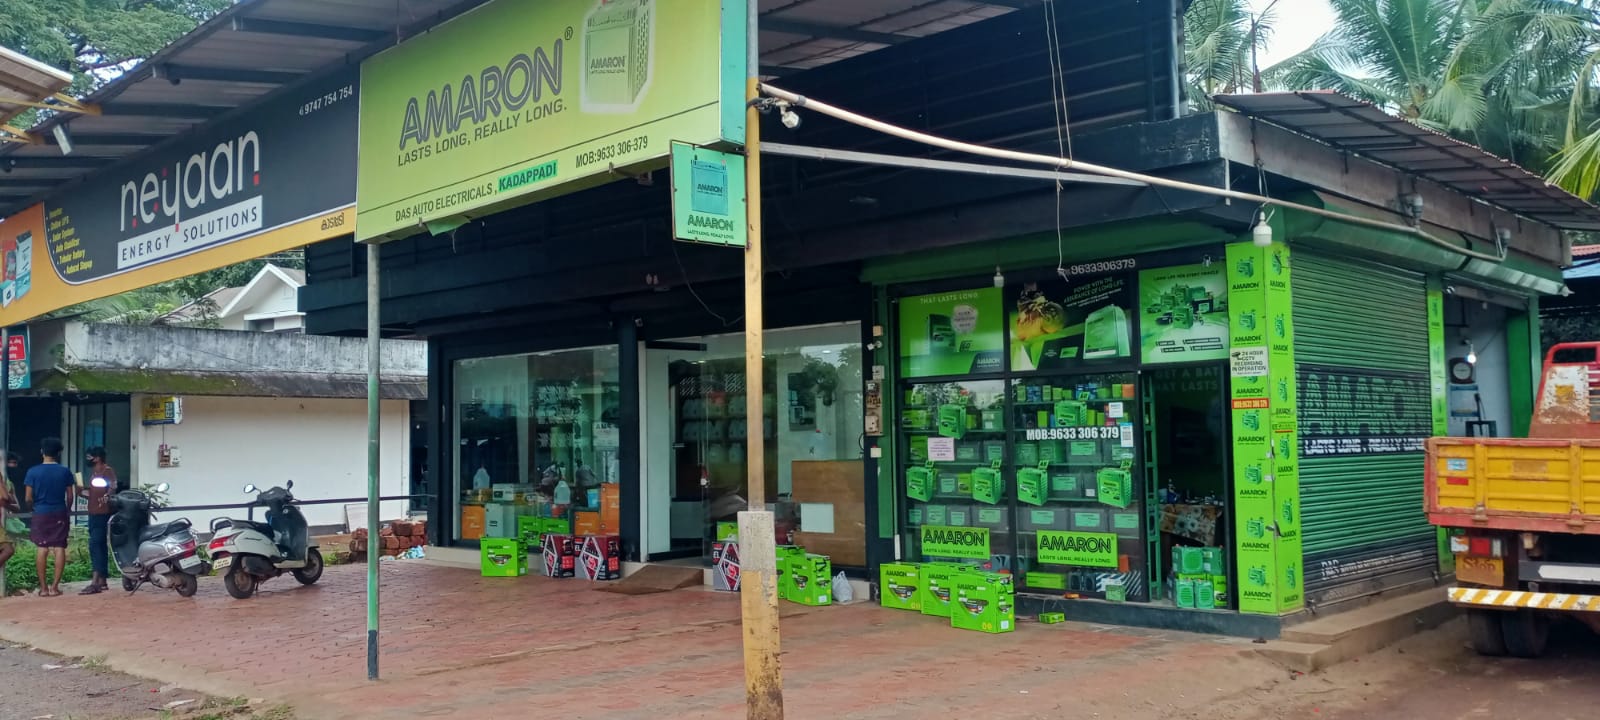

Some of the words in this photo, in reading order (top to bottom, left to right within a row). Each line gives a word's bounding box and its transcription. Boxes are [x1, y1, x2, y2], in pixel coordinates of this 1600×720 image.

[591, 56, 625, 69] AMARON
[304, 98, 322, 114] 9747
[324, 91, 337, 106] 754
[339, 84, 353, 100] 754
[400, 38, 563, 150] AMARON
[397, 145, 432, 167] LASTS
[435, 132, 471, 154] LONG,
[474, 113, 521, 141] REALLY
[525, 98, 568, 123] LONG.
[575, 144, 615, 169] MOB:9633
[395, 207, 412, 222] DAS
[412, 201, 434, 218] AUTO
[435, 182, 493, 210] ELECTRICALS
[498, 162, 557, 190] KADAPPADI
[697, 183, 722, 193] AMARON
[687, 214, 734, 231] AMARON
[122, 233, 171, 261] ENERGY
[183, 206, 258, 243] SOLUTIONS
[1071, 258, 1136, 275] 9633306379
[1232, 282, 1259, 290] AMARON
[920, 295, 935, 304] THAT
[938, 294, 957, 302] LASTS
[1027, 428, 1076, 440] MOB:9633
[1078, 427, 1098, 439] 306
[1100, 426, 1119, 438] 379
[1305, 439, 1335, 454] LASTS
[1337, 439, 1361, 453] LONG
[1368, 438, 1401, 452] REALLY
[923, 529, 984, 547] AMARON
[1040, 534, 1112, 554] AMARON
[1243, 590, 1272, 598] AMARON
